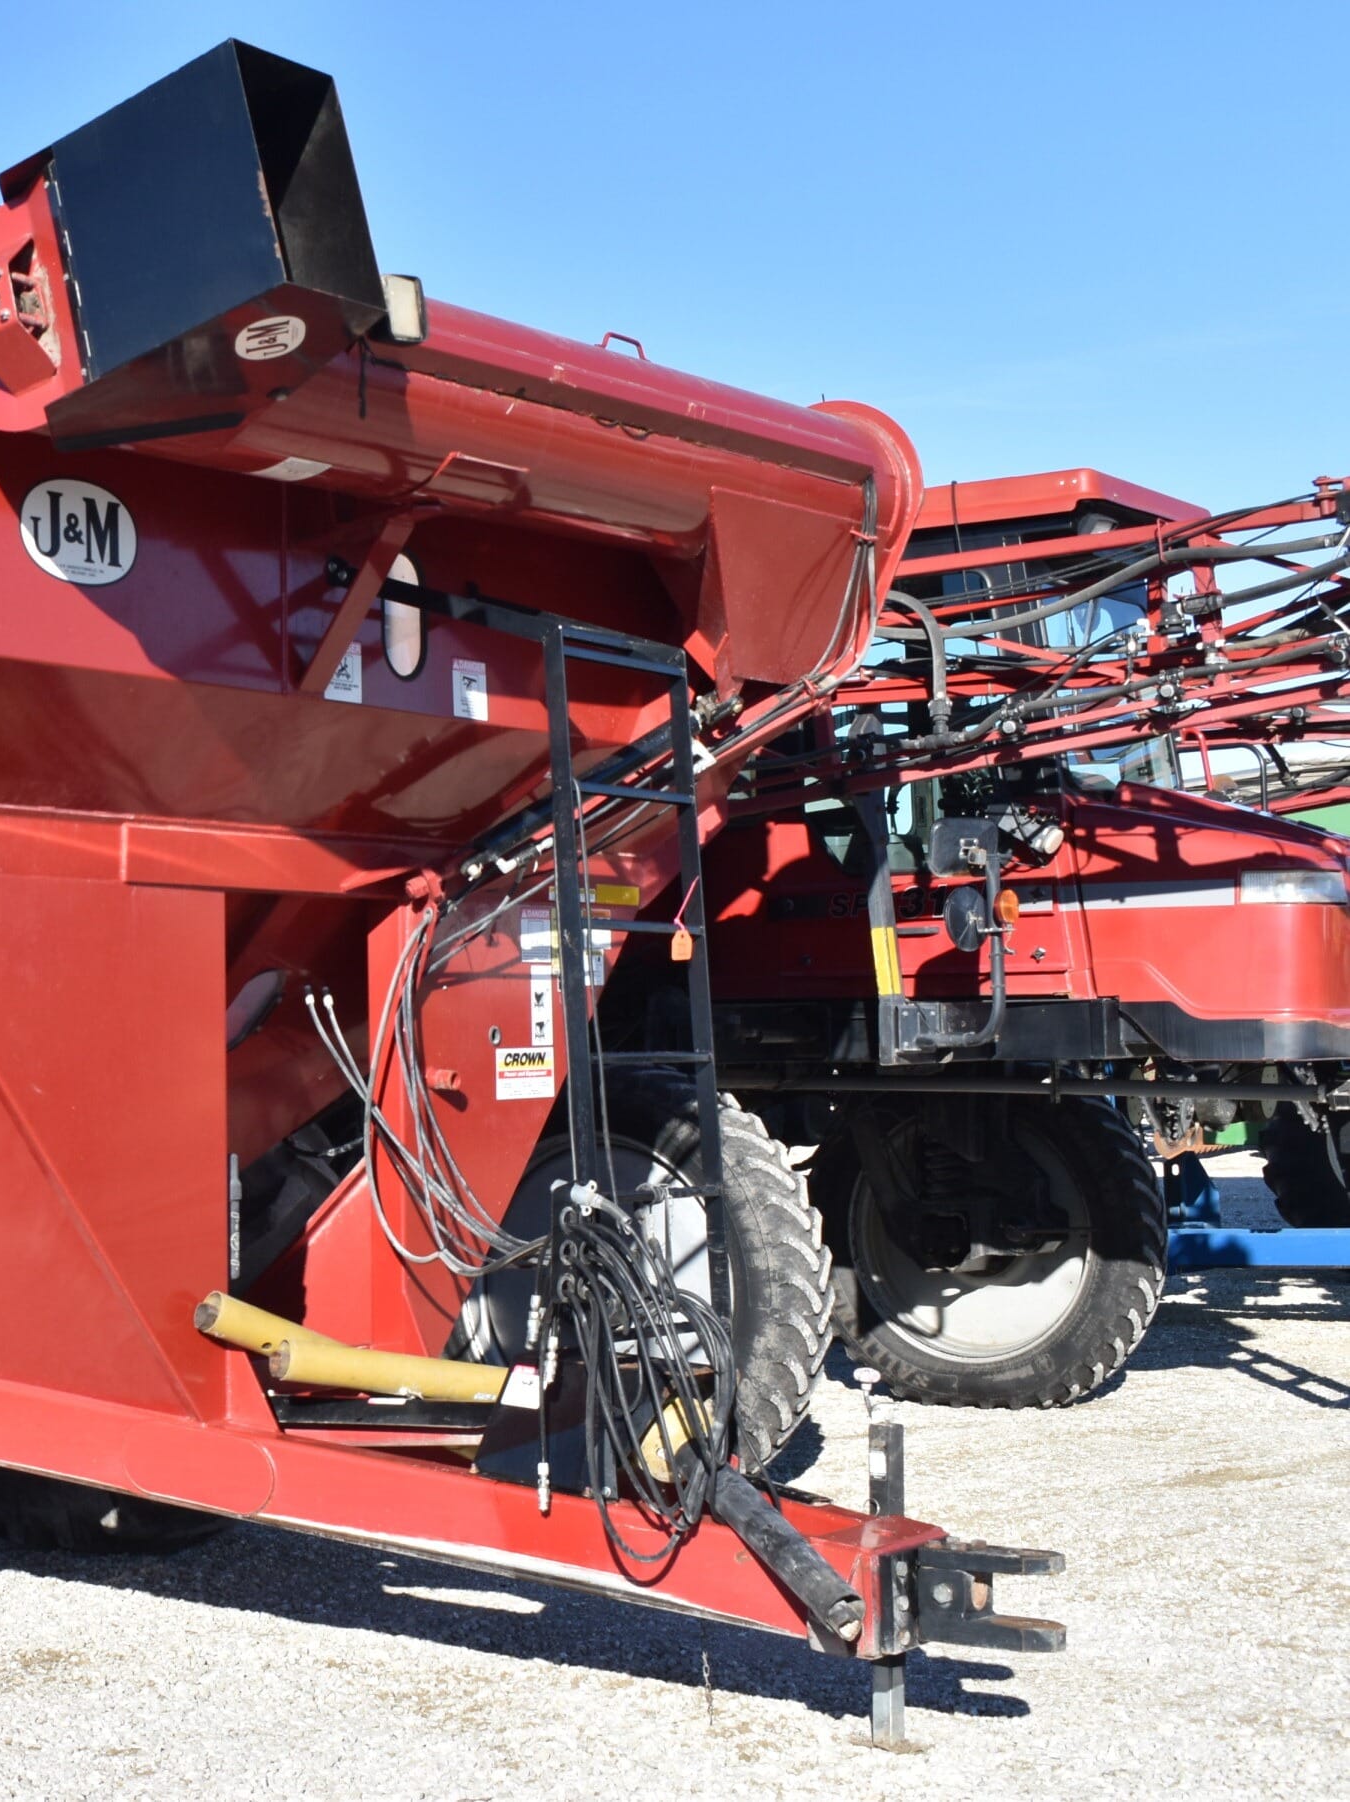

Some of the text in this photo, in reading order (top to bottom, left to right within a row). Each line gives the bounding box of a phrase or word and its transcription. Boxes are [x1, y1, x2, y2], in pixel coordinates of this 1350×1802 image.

[246, 320, 290, 356] J&M
[30, 490, 122, 568] J&M
[504, 1052, 546, 1067] CROWN
